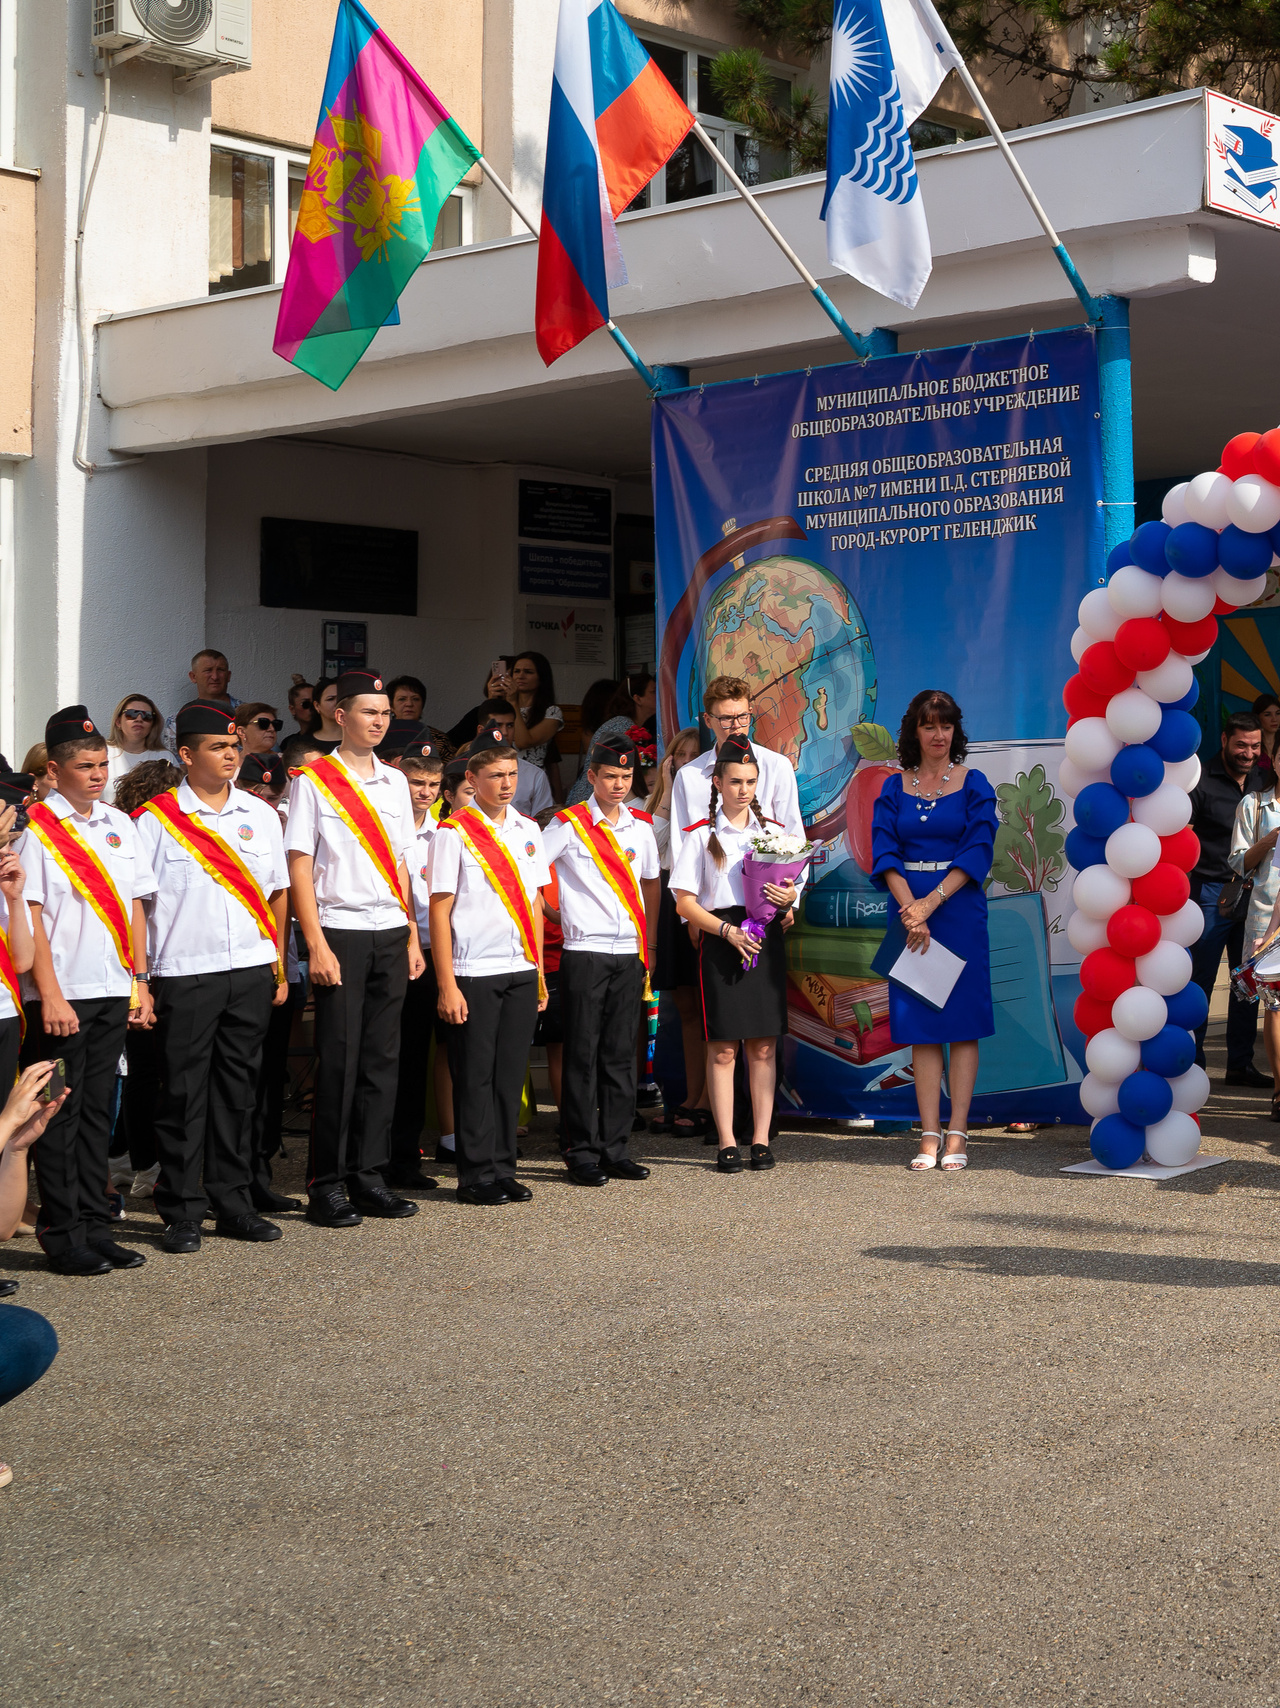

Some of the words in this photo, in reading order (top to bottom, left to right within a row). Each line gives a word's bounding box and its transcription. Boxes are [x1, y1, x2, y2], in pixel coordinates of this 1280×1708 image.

[816, 379, 949, 412] МУНИЦИПАЛЬНОЕ
[952, 364, 1049, 395] БЮДЖЕТНОЕ
[791, 401, 971, 439] ОБЩЕОБРАЗОВАТЕЛЬНОЕ
[974, 384, 1080, 414] УЧРЕЖДЕНИЕ
[797, 487, 851, 508] ШКОЛА
[853, 483, 877, 501] №7
[880, 477, 936, 499] ИМЕНИ
[939, 475, 968, 493] П.Д.
[971, 457, 1072, 489] СТЕРНЯЕВОЙ
[804, 461, 869, 484] СРЕДНЯЯ
[872, 436, 1063, 475] ОБЩЕОБРАЗОВАТЕЛЬНАЯ
[805, 499, 951, 531] МУНИЦИПАЛЬНОГО
[953, 486, 1064, 515] ОБРАЗОВАНИЯ
[831, 525, 940, 552] ГОРОД-КУРОРТ
[943, 514, 1037, 541] ГЕЛЕНДЖИК
[528, 552, 554, 563] Школа
[559, 556, 603, 568] победитель
[529, 621, 560, 630] ТОЧКА
[574, 624, 603, 632] РОСТА
